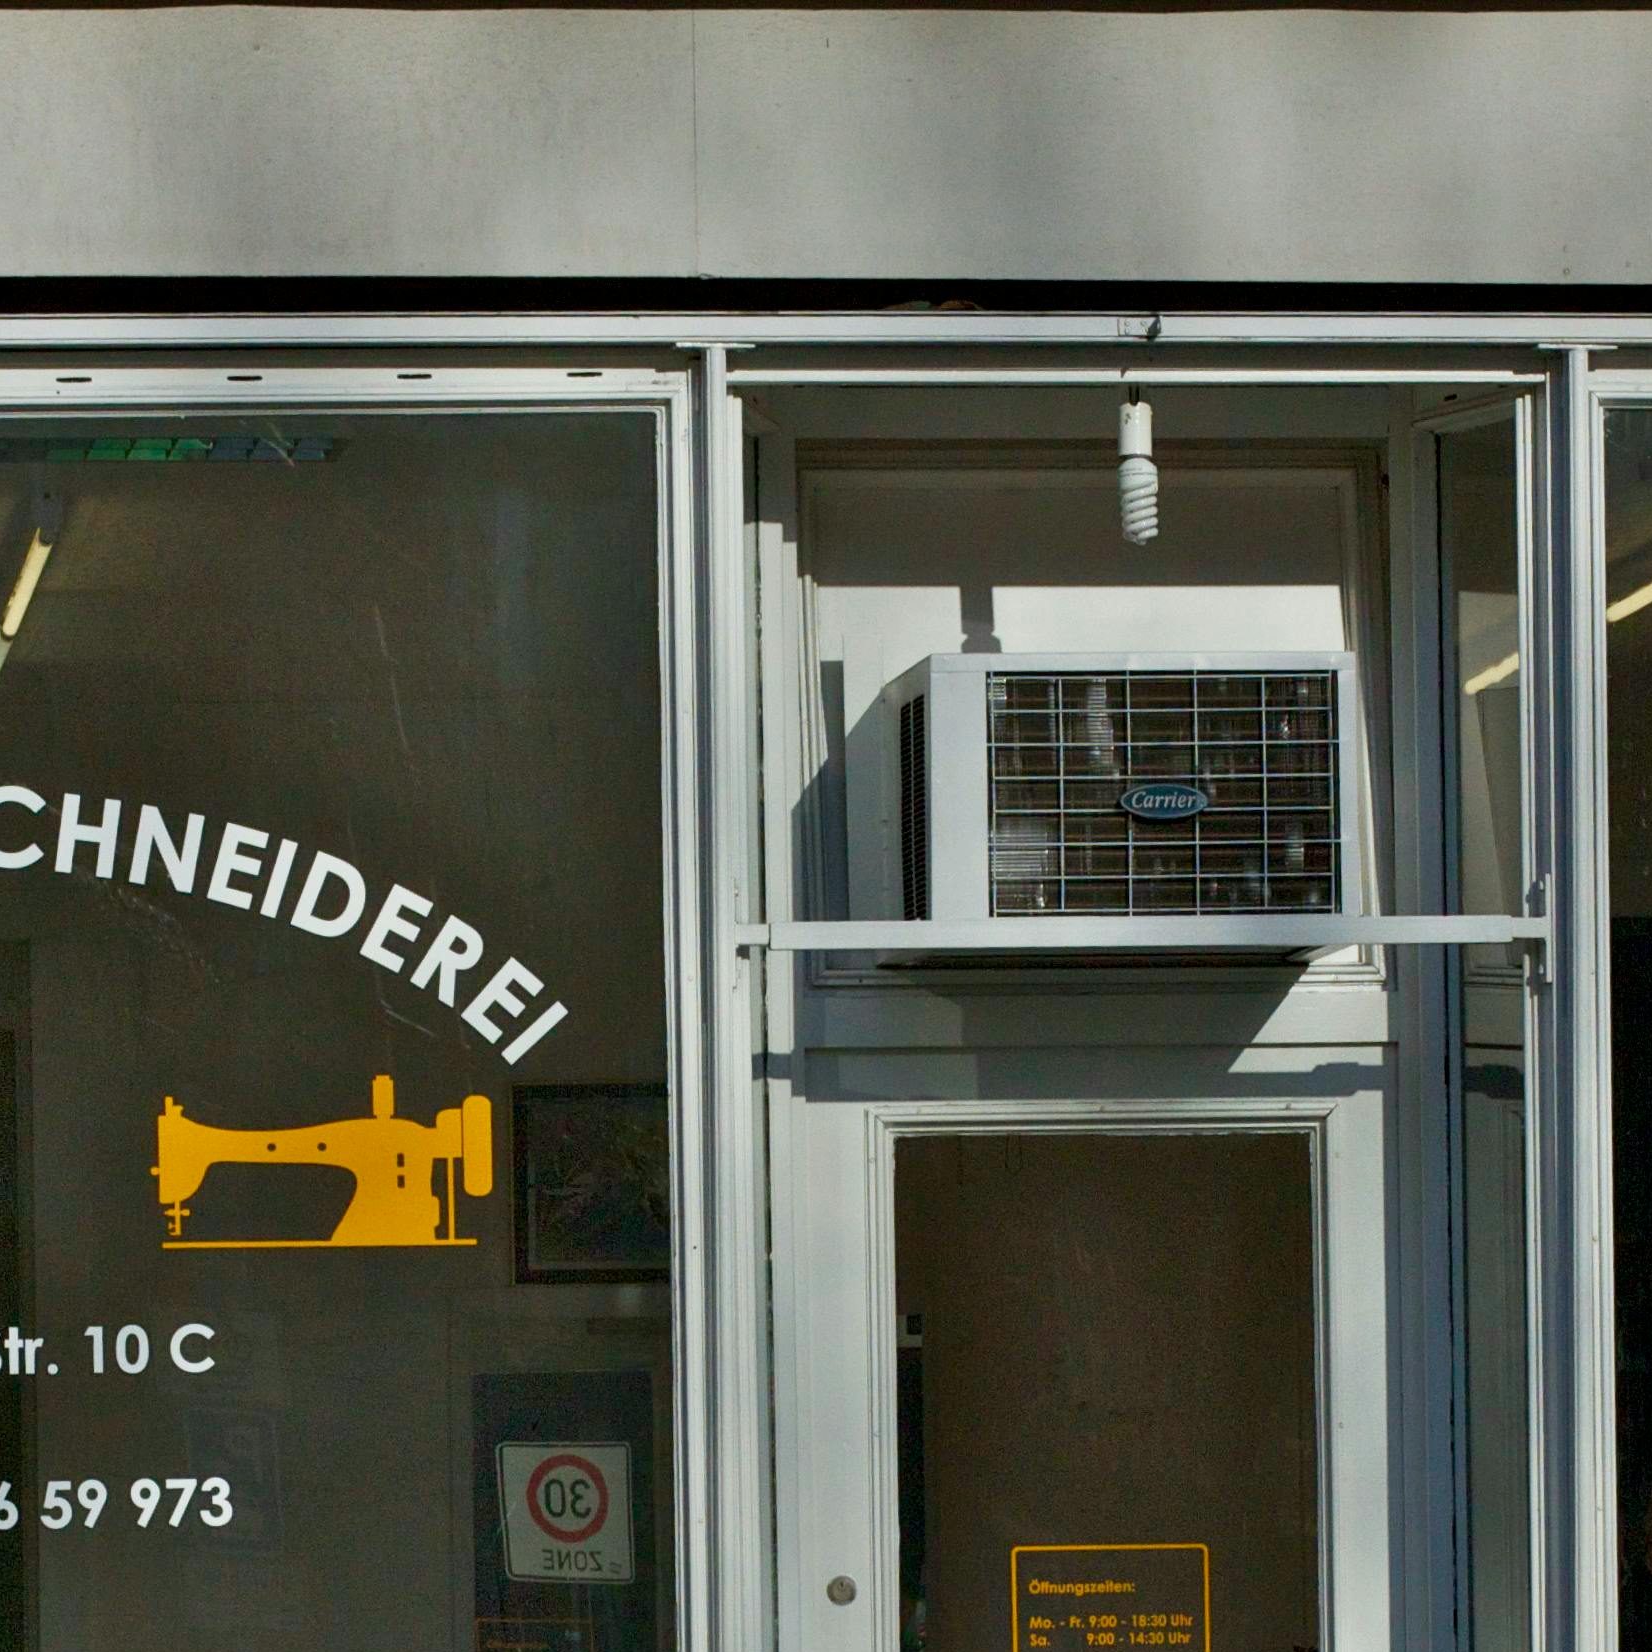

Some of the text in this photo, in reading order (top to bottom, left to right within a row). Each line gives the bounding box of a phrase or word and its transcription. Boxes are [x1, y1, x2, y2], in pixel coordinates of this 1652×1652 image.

[1131, 791, 1197, 809] Carrier
[83, 1323, 150, 1375] 10
[169, 1322, 216, 1374] C
[39, 1478, 109, 1531] 59
[129, 1475, 234, 1529] 973
[1028, 1579, 1136, 1597] Öffnungszeiten:
[1029, 1616, 1056, 1630] Mo.
[1069, 1616, 1085, 1629] Fr.
[1089, 1615, 1118, 1629] 9:00
[1132, 1614, 1167, 1628] 18:30
[1170, 1613, 1194, 1628] Uhr
[1029, 1633, 1051, 1647] Sa.
[1086, 1632, 1115, 1646] 9:00
[1129, 1632, 1165, 1645] 14:30
[1168, 1631, 1192, 1645] Uhr
